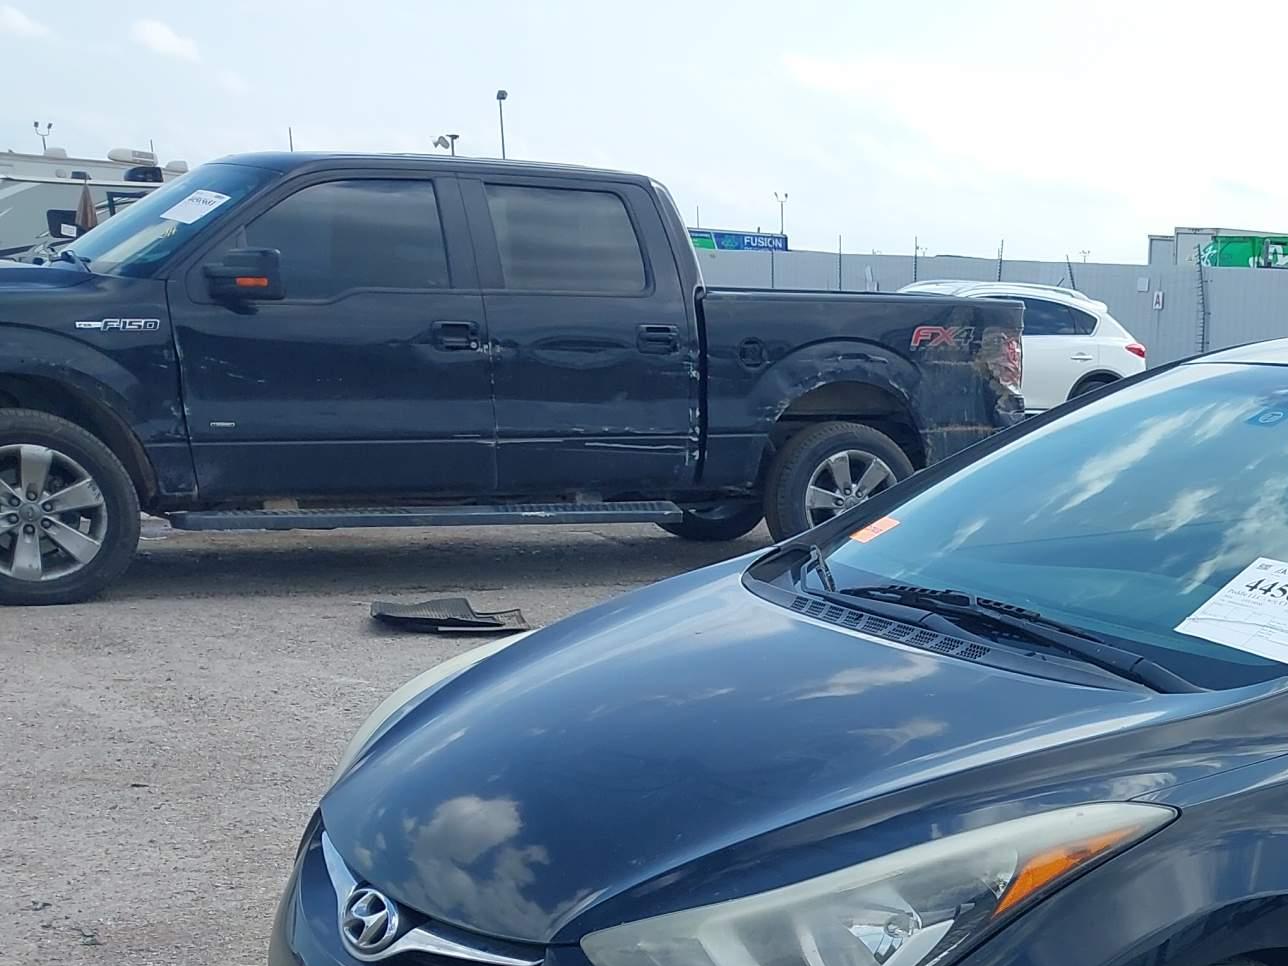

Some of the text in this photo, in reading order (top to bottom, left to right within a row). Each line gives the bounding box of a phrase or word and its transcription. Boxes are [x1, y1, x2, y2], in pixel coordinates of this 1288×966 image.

[744, 236, 782, 248] FUSION
[1154, 293, 1161, 307] A
[910, 326, 976, 347] FX4
